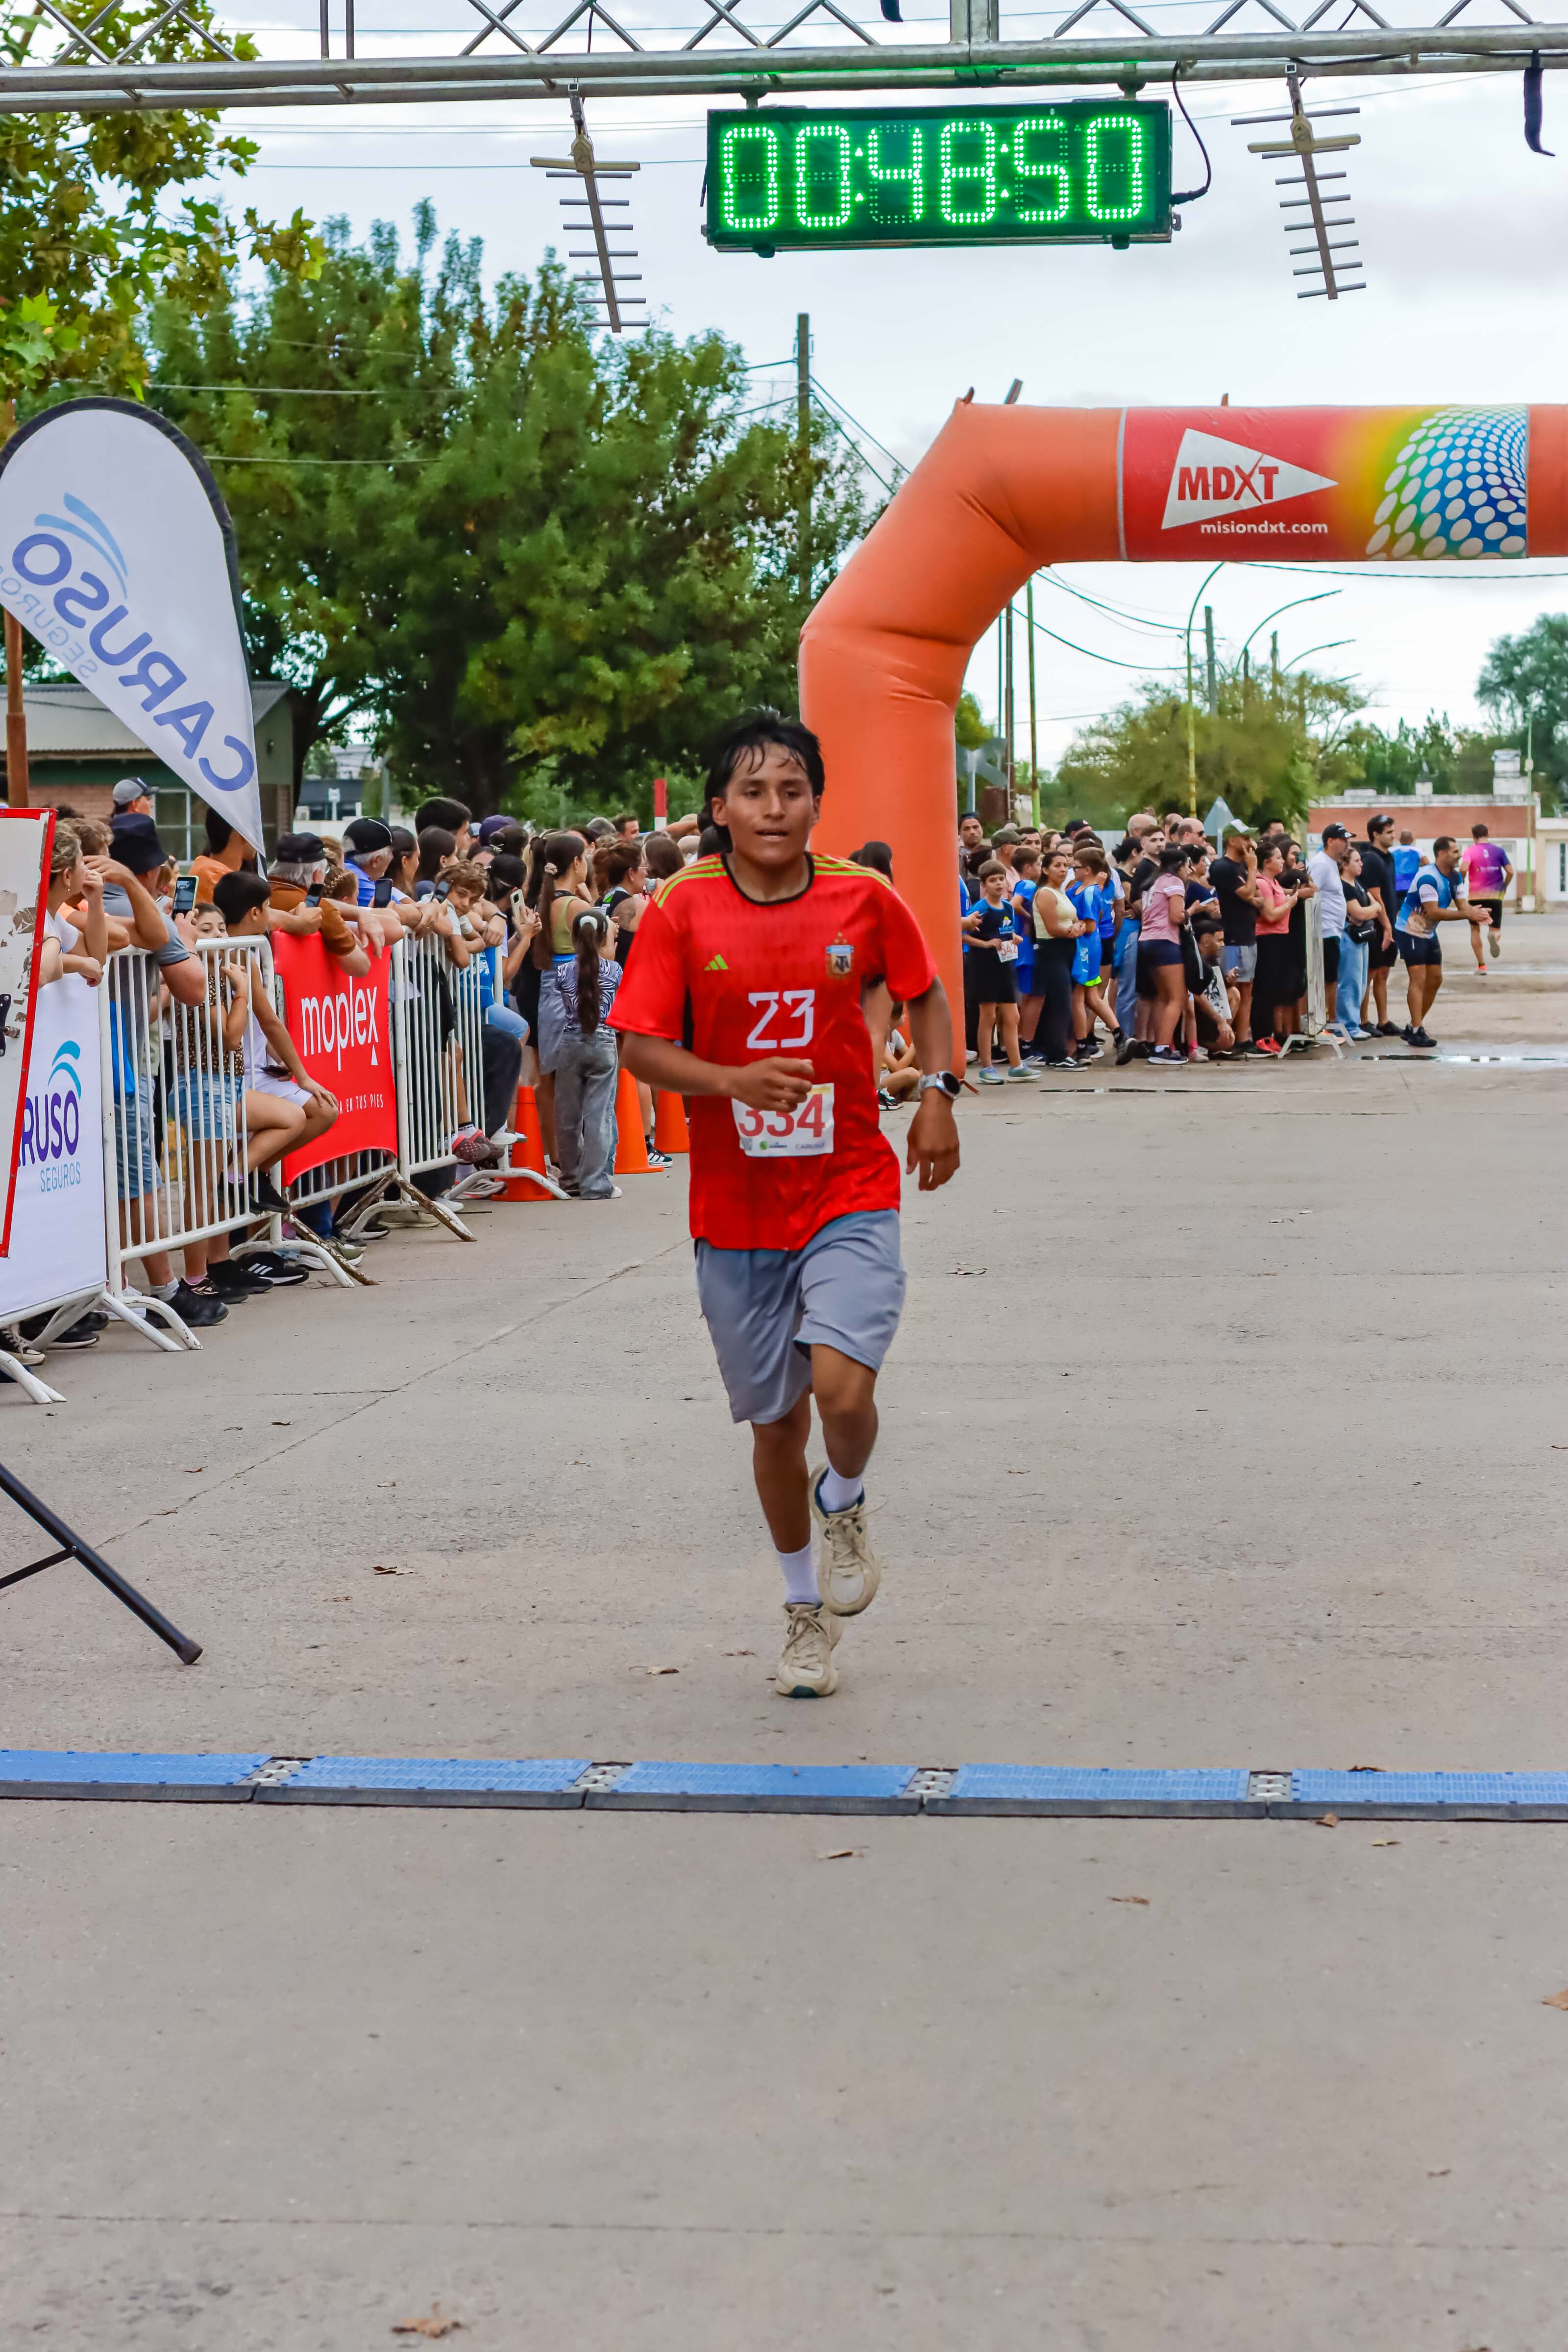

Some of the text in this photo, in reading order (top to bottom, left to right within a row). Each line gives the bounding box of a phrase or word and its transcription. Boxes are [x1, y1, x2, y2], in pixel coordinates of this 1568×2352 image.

[723, 116, 1142, 229] 00:48:50
[1177, 454, 1279, 504] MDXT
[1200, 520, 1328, 534] misiondxt.com
[301, 976, 379, 1072] moplex
[746, 989, 815, 1049] 23
[18, 1090, 79, 1167] RUSO
[346, 1098, 353, 1113] EN
[356, 1094, 367, 1110] TUS
[370, 1093, 383, 1108] PIES
[40, 1161, 81, 1193] SEGUROS
